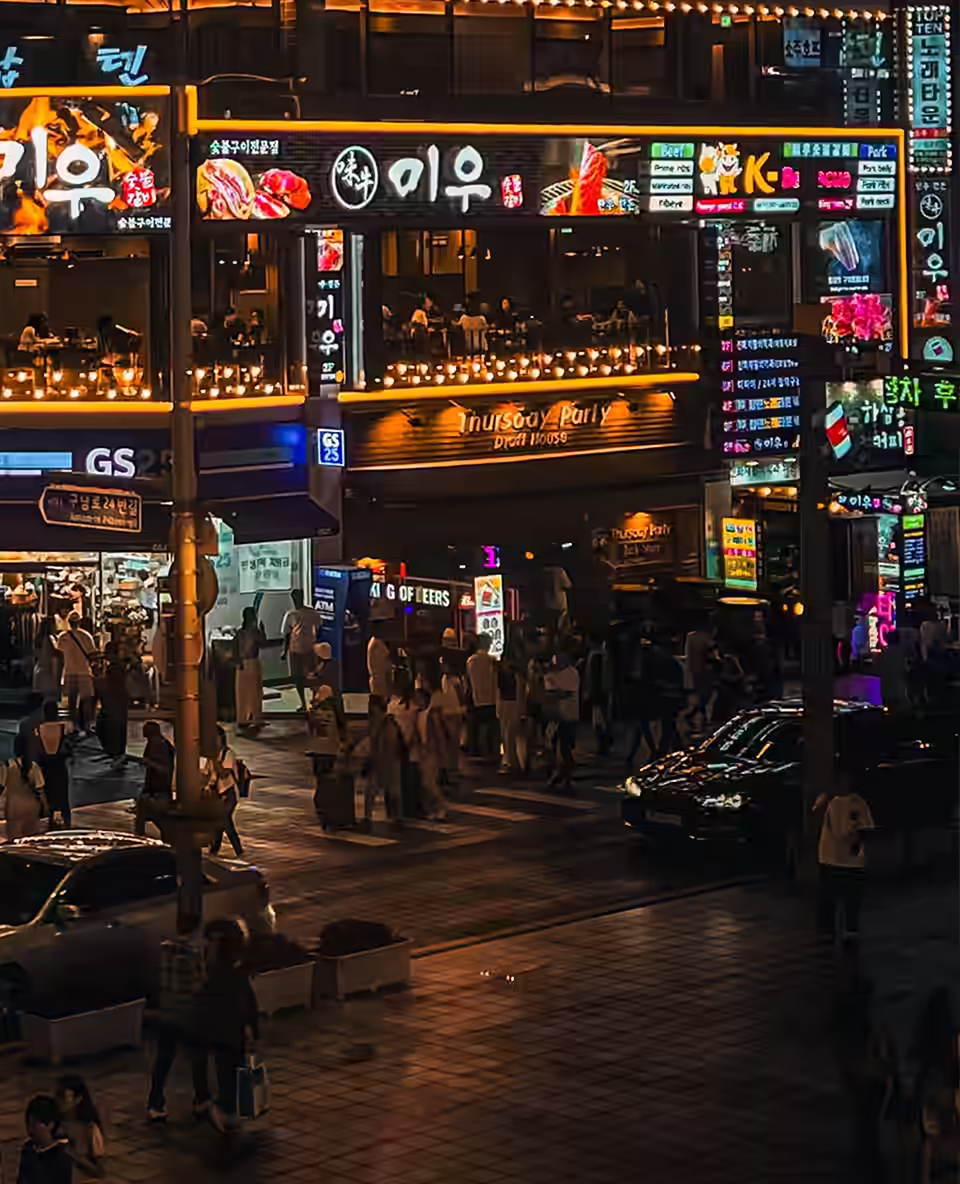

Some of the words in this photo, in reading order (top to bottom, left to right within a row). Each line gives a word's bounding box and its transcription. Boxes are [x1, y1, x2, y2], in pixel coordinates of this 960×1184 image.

[915, 22, 943, 34] TEN
[920, 38, 940, 125] 노래타운
[867, 144, 888, 158] Pork
[388, 143, 492, 213] 미우
[916, 220, 949, 284] 미우
[459, 409, 549, 436] Thursday
[559, 403, 611, 426] Party
[321, 432, 340, 449] GS
[538, 431, 569, 446] House
[322, 448, 340, 463] 25
[399, 584, 415, 602] OF
